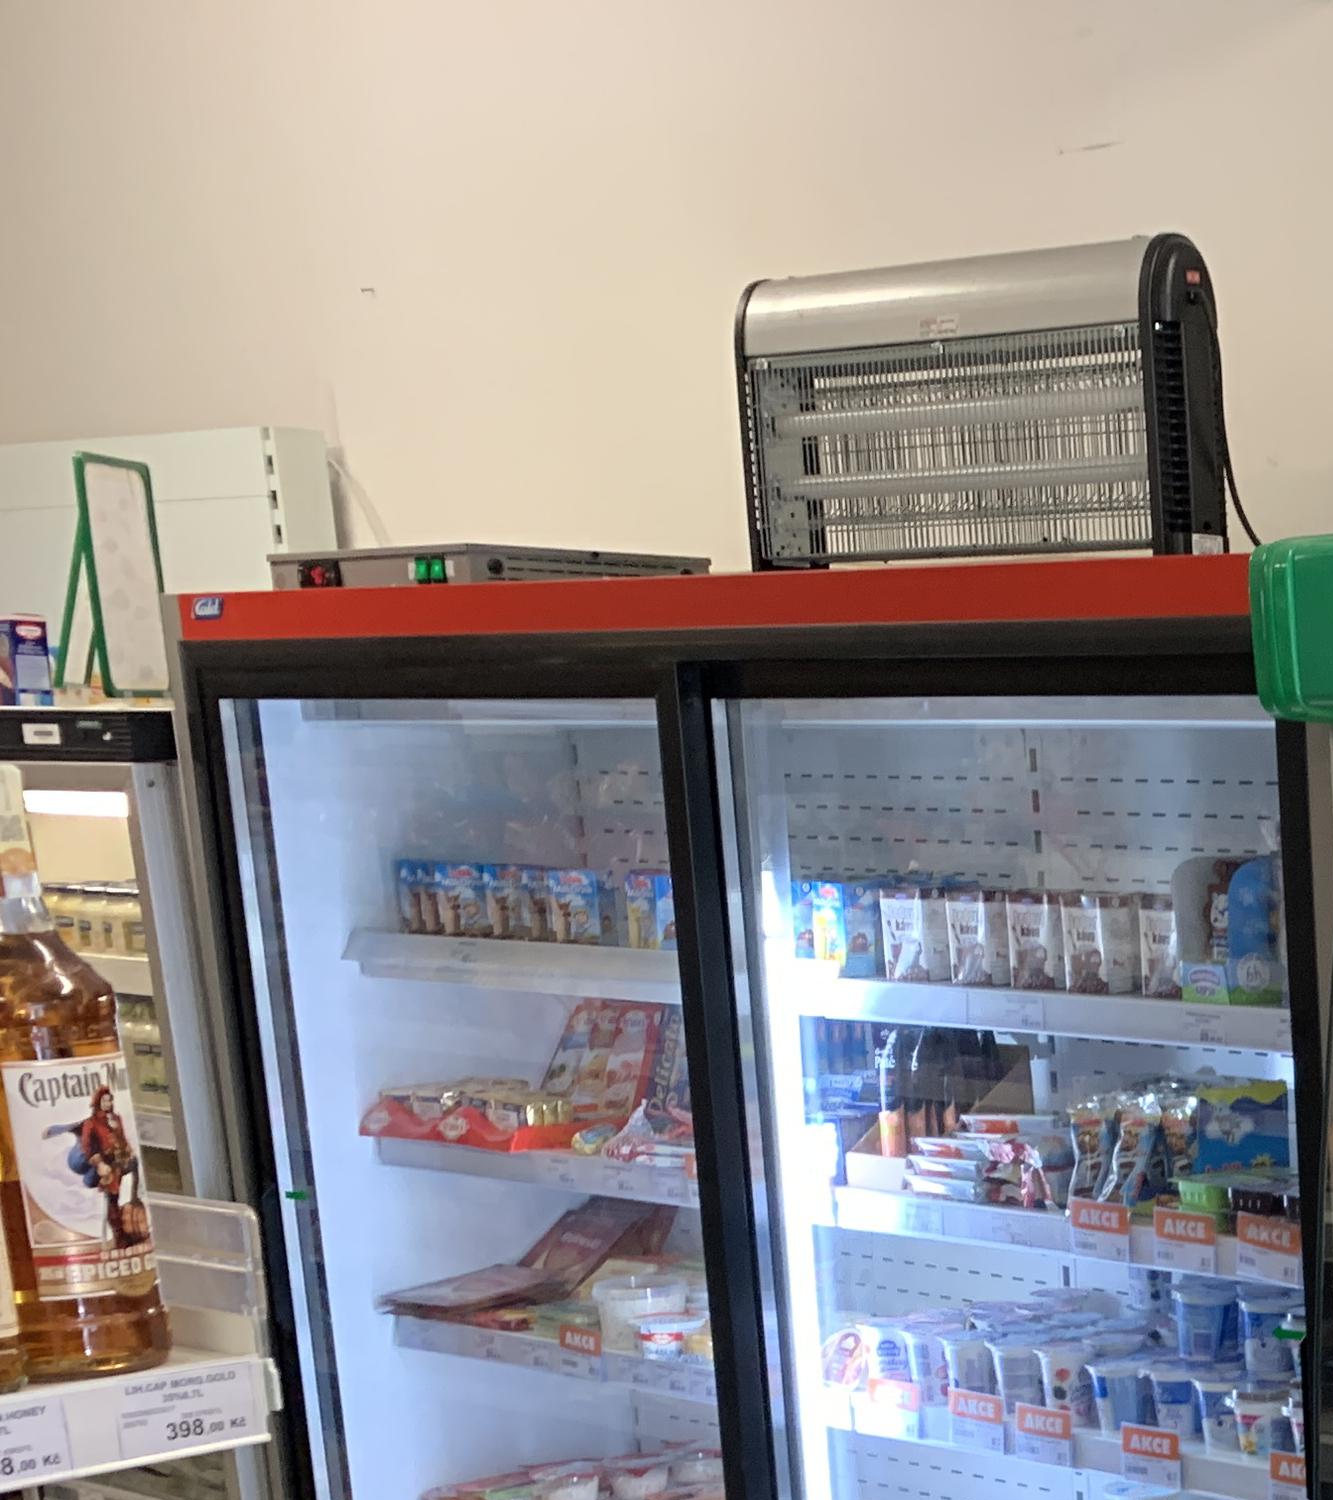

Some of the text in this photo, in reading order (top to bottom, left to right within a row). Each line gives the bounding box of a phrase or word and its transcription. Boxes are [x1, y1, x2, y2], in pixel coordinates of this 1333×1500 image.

[18, 1066, 102, 1108] Captain
[1077, 1208, 1120, 1231] AKCE
[1162, 1216, 1207, 1240] AKCE
[1245, 1223, 1291, 1248] AKCE
[565, 1331, 596, 1352] AKCE
[954, 1398, 996, 1421] AKCE
[1023, 1413, 1064, 1435] AKCE
[1128, 1433, 1172, 1456] AKCE
